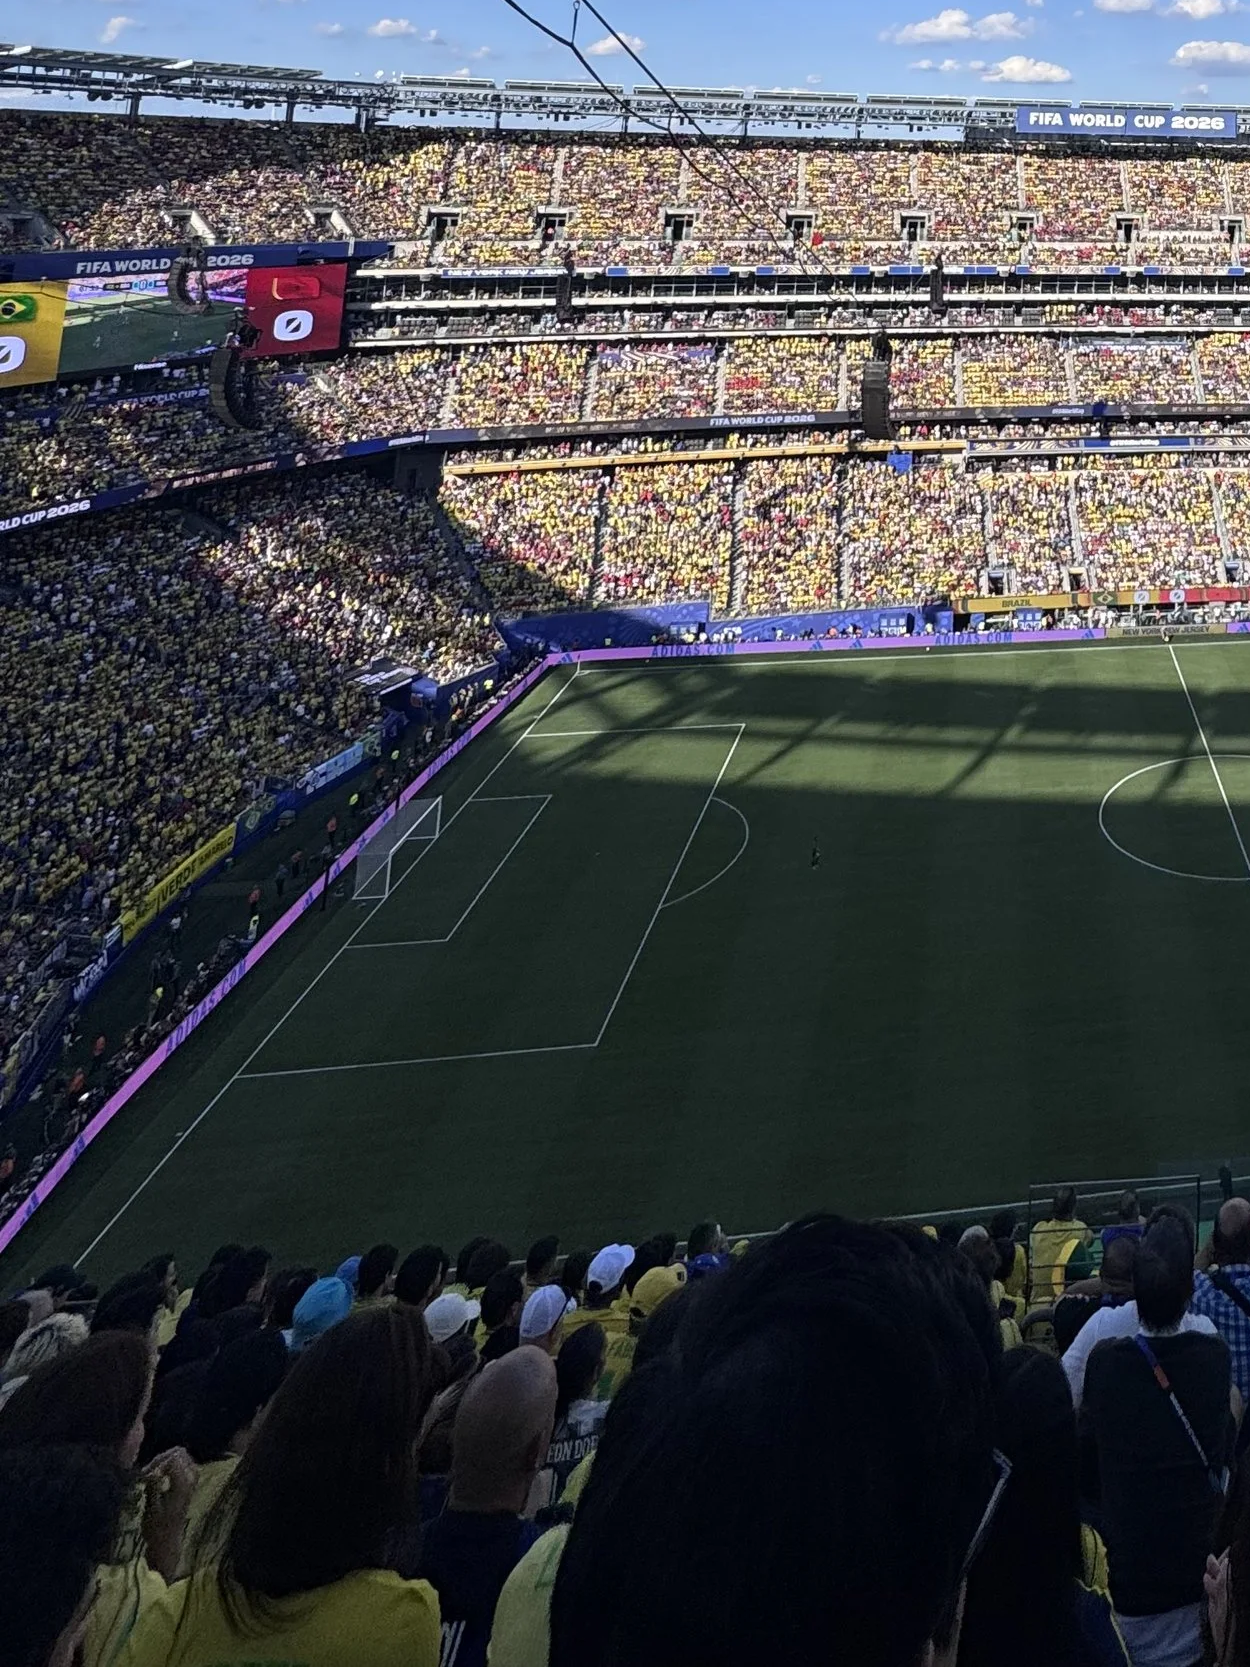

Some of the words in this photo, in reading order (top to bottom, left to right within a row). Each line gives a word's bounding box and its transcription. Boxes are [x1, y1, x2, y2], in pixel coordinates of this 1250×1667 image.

[1029, 112, 1063, 126] FIFA
[1069, 113, 1125, 127] WORLD
[1134, 115, 1166, 128] CUP
[1171, 116, 1225, 130] 2026
[76, 262, 111, 275] FIFA
[115, 258, 171, 272] WORLD
[207, 254, 254, 267] 2026
[710, 418, 730, 426] FIFA
[731, 417, 763, 425] WORLD
[765, 416, 783, 424] CUP
[784, 414, 815, 423] 2026
[22, 510, 46, 525] CUP
[46, 499, 91, 519] 2026
[1002, 599, 1032, 608] BRAZIL
[1122, 628, 1141, 636] NEW
[1142, 627, 1160, 635] YORK
[1181, 625, 1210, 634] JERSEY
[162, 859, 197, 902] VERDE
